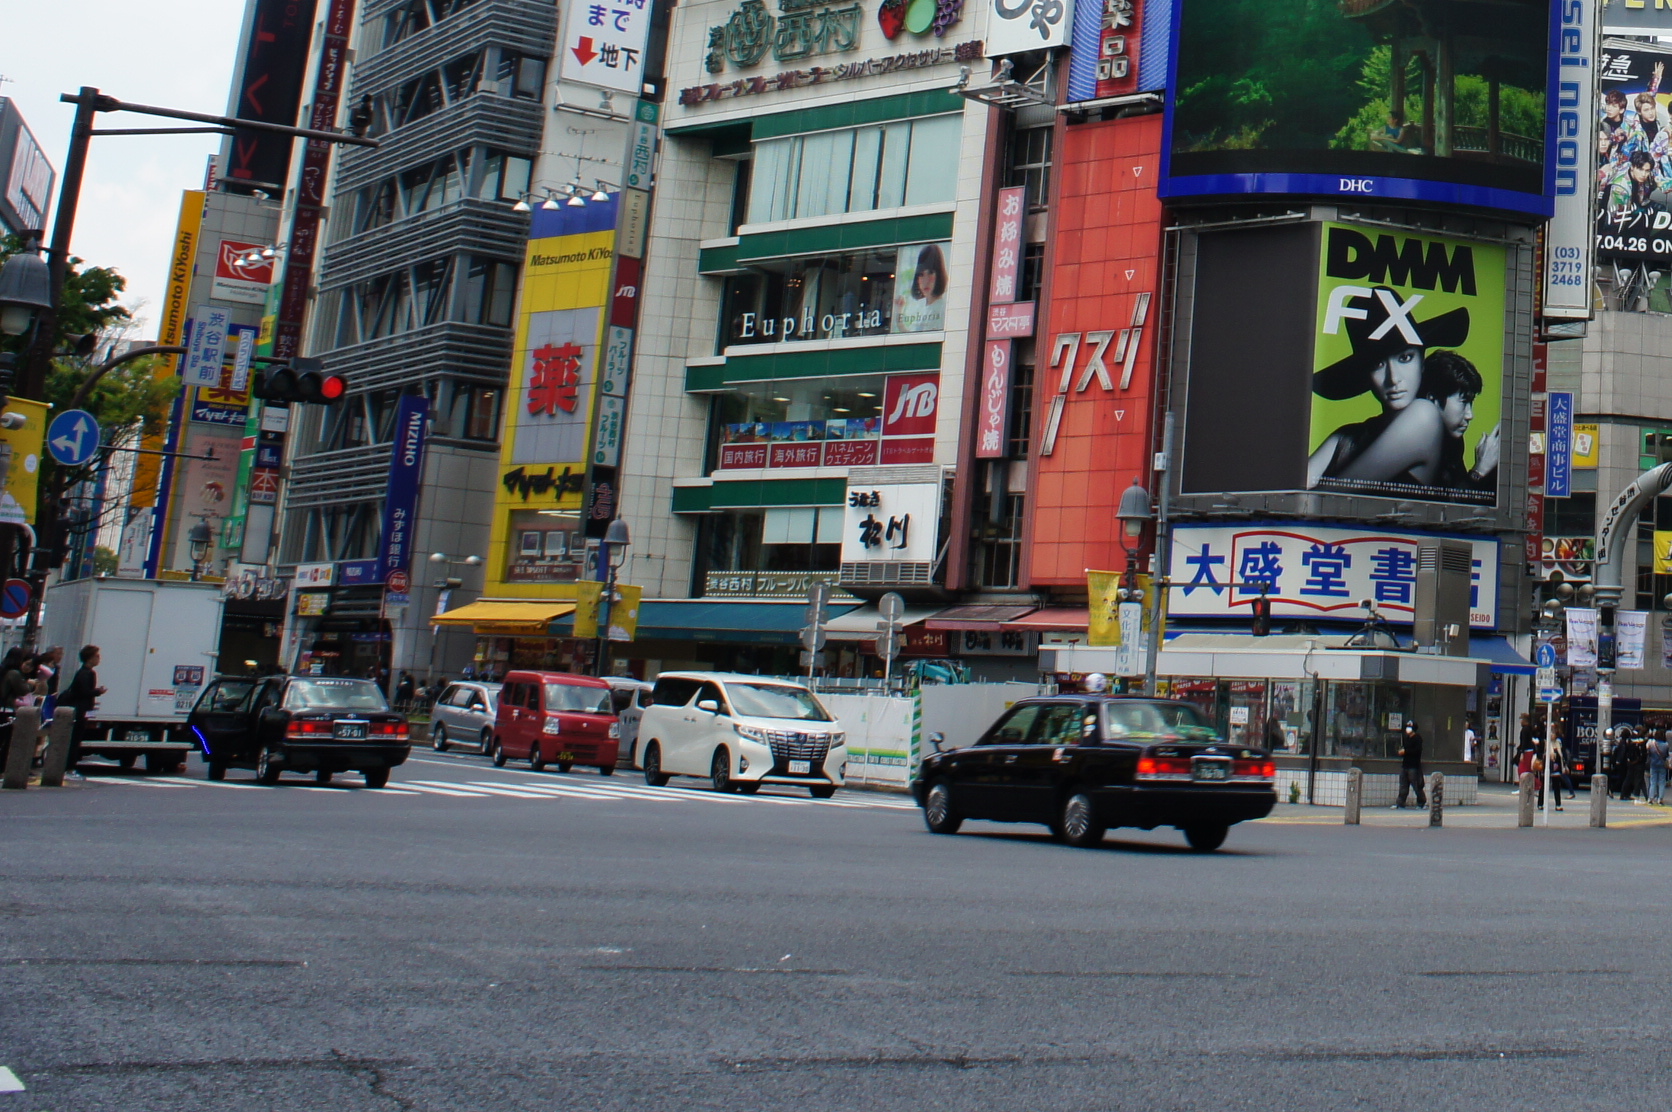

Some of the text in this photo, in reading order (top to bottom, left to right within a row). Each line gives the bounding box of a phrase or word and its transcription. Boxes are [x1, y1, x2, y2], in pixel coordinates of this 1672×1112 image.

[588, 4, 631, 33] まで
[599, 42, 640, 72] 地下
[1555, 80, 1582, 197] neon
[1339, 179, 1373, 193] DHC
[531, 250, 587, 267] Matsumoto
[995, 193, 1019, 296] お好み焼
[1326, 226, 1478, 297] DMM
[1554, 246, 1581, 259] (03)
[1551, 261, 1582, 274] 3719
[1551, 274, 1582, 287] 2468
[616, 284, 636, 297] JTB
[740, 302, 883, 344] Euphoria
[1322, 285, 1424, 346] FX
[198, 312, 226, 381] 渋谷駅前
[527, 341, 584, 416] 薬
[981, 344, 1006, 451] もんじゃ焼
[888, 382, 938, 426] JTB
[404, 410, 423, 467] MIZUHO
[724, 450, 765, 464] 国内旅行
[774, 447, 818, 462] 海外旅行
[1551, 397, 1569, 492] 大盛堂商事ビル
[826, 453, 875, 466] ウエディング
[848, 489, 881, 508] うなぎ
[388, 507, 407, 568] みずほ銀行
[858, 512, 911, 551] 松川
[1183, 541, 1481, 614] 大盛堂書
